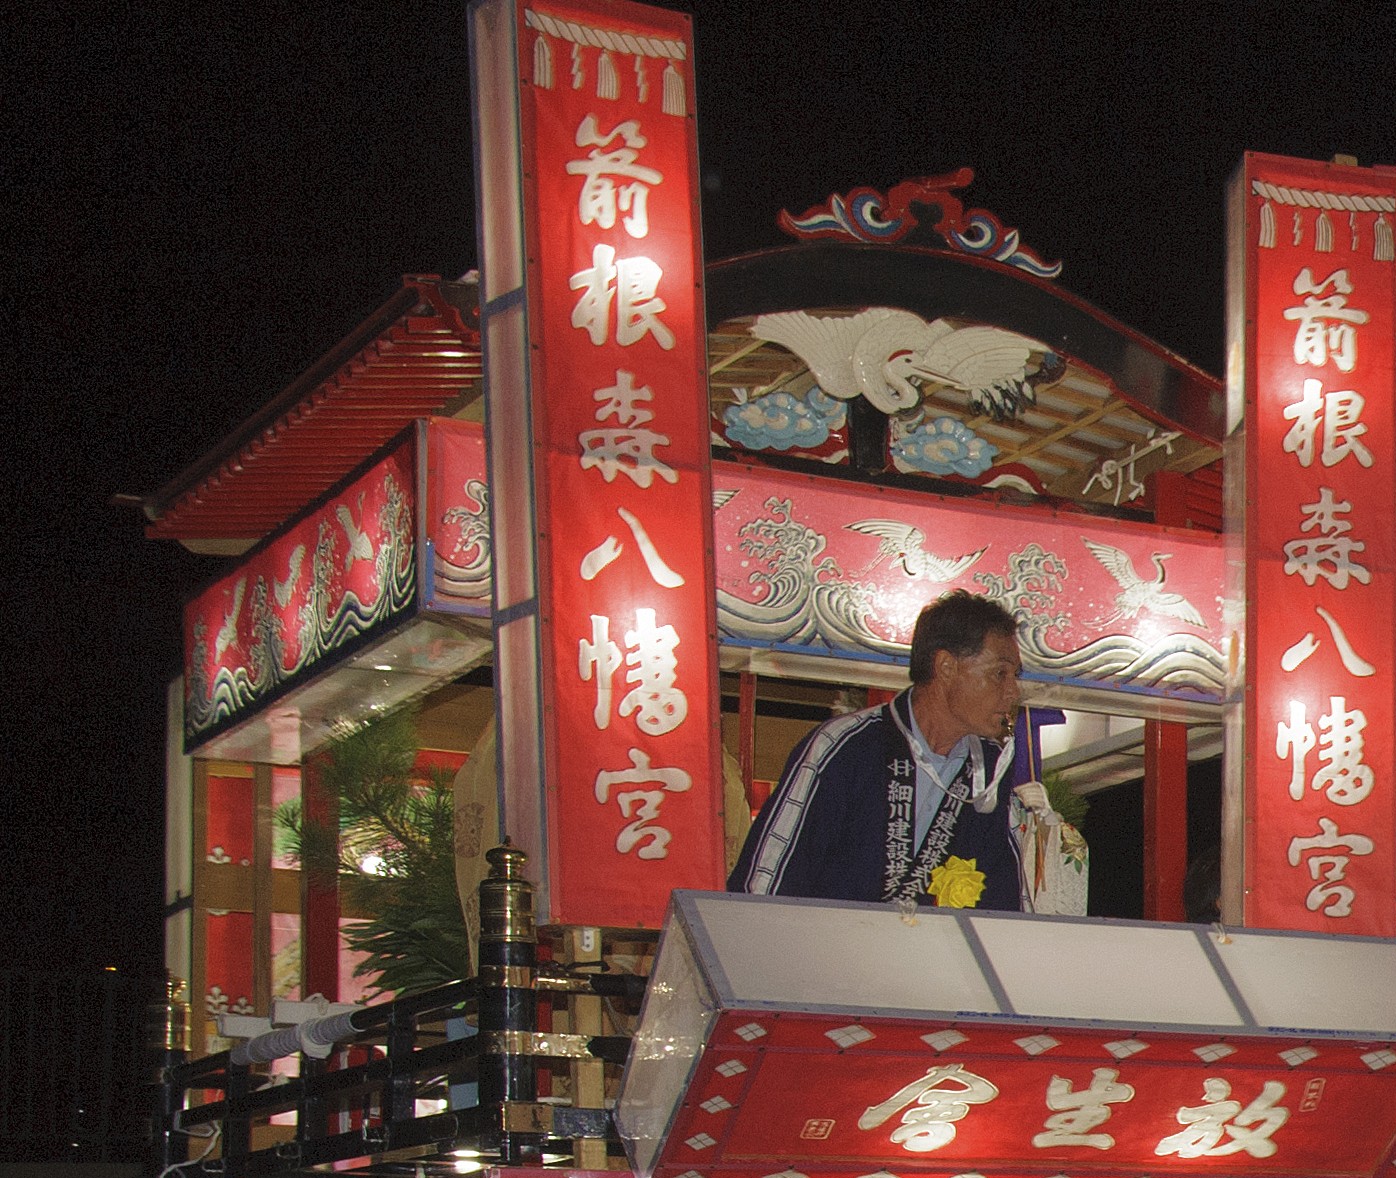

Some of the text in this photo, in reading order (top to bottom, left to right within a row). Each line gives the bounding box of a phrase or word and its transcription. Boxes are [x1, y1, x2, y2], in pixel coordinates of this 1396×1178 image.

[882, 780, 913, 900] 細川建設株式
